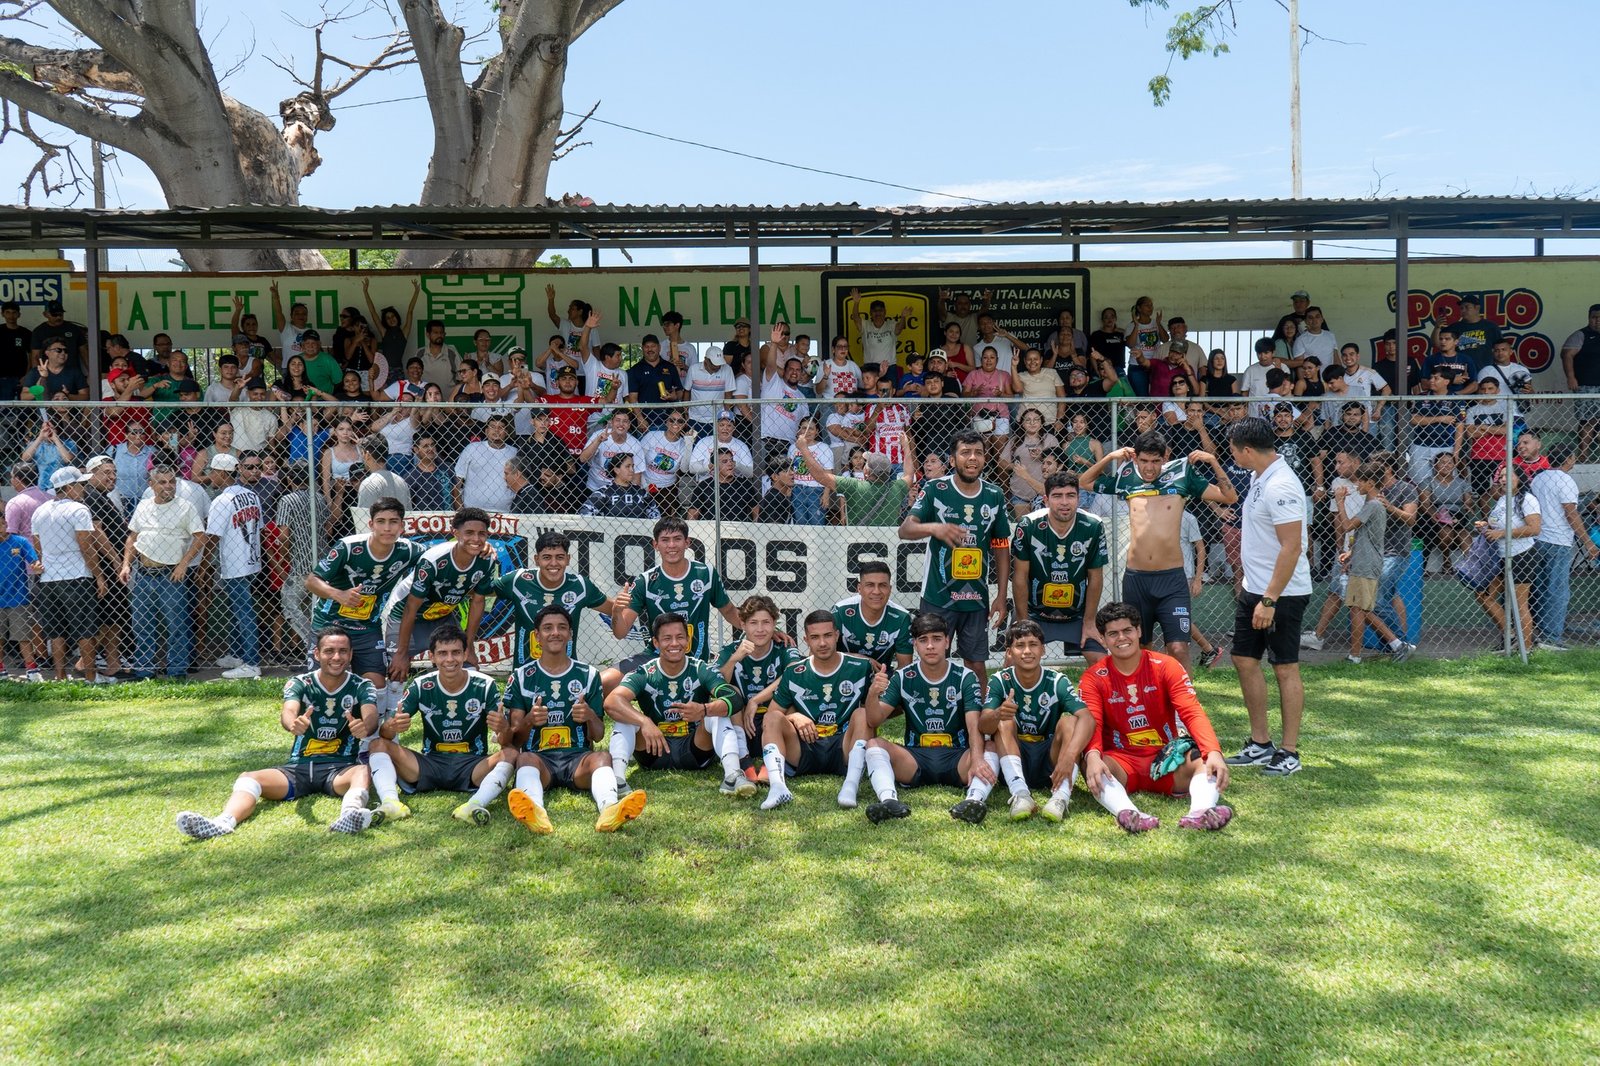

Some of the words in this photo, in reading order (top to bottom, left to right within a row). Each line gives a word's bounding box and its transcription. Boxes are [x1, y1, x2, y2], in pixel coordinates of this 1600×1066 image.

[0, 279, 59, 302] ORES
[996, 287, 1071, 300] ITALIANAS
[1406, 290, 1541, 329] POLO
[612, 494, 644, 505] FOX
[1051, 573, 1068, 581] YAYA
[548, 713, 564, 722] YAYA
[926, 721, 944, 730] YAYA
[1129, 717, 1149, 729] YAYA
[318, 729, 336, 738] YAYA
[443, 731, 462, 740] YAYA
